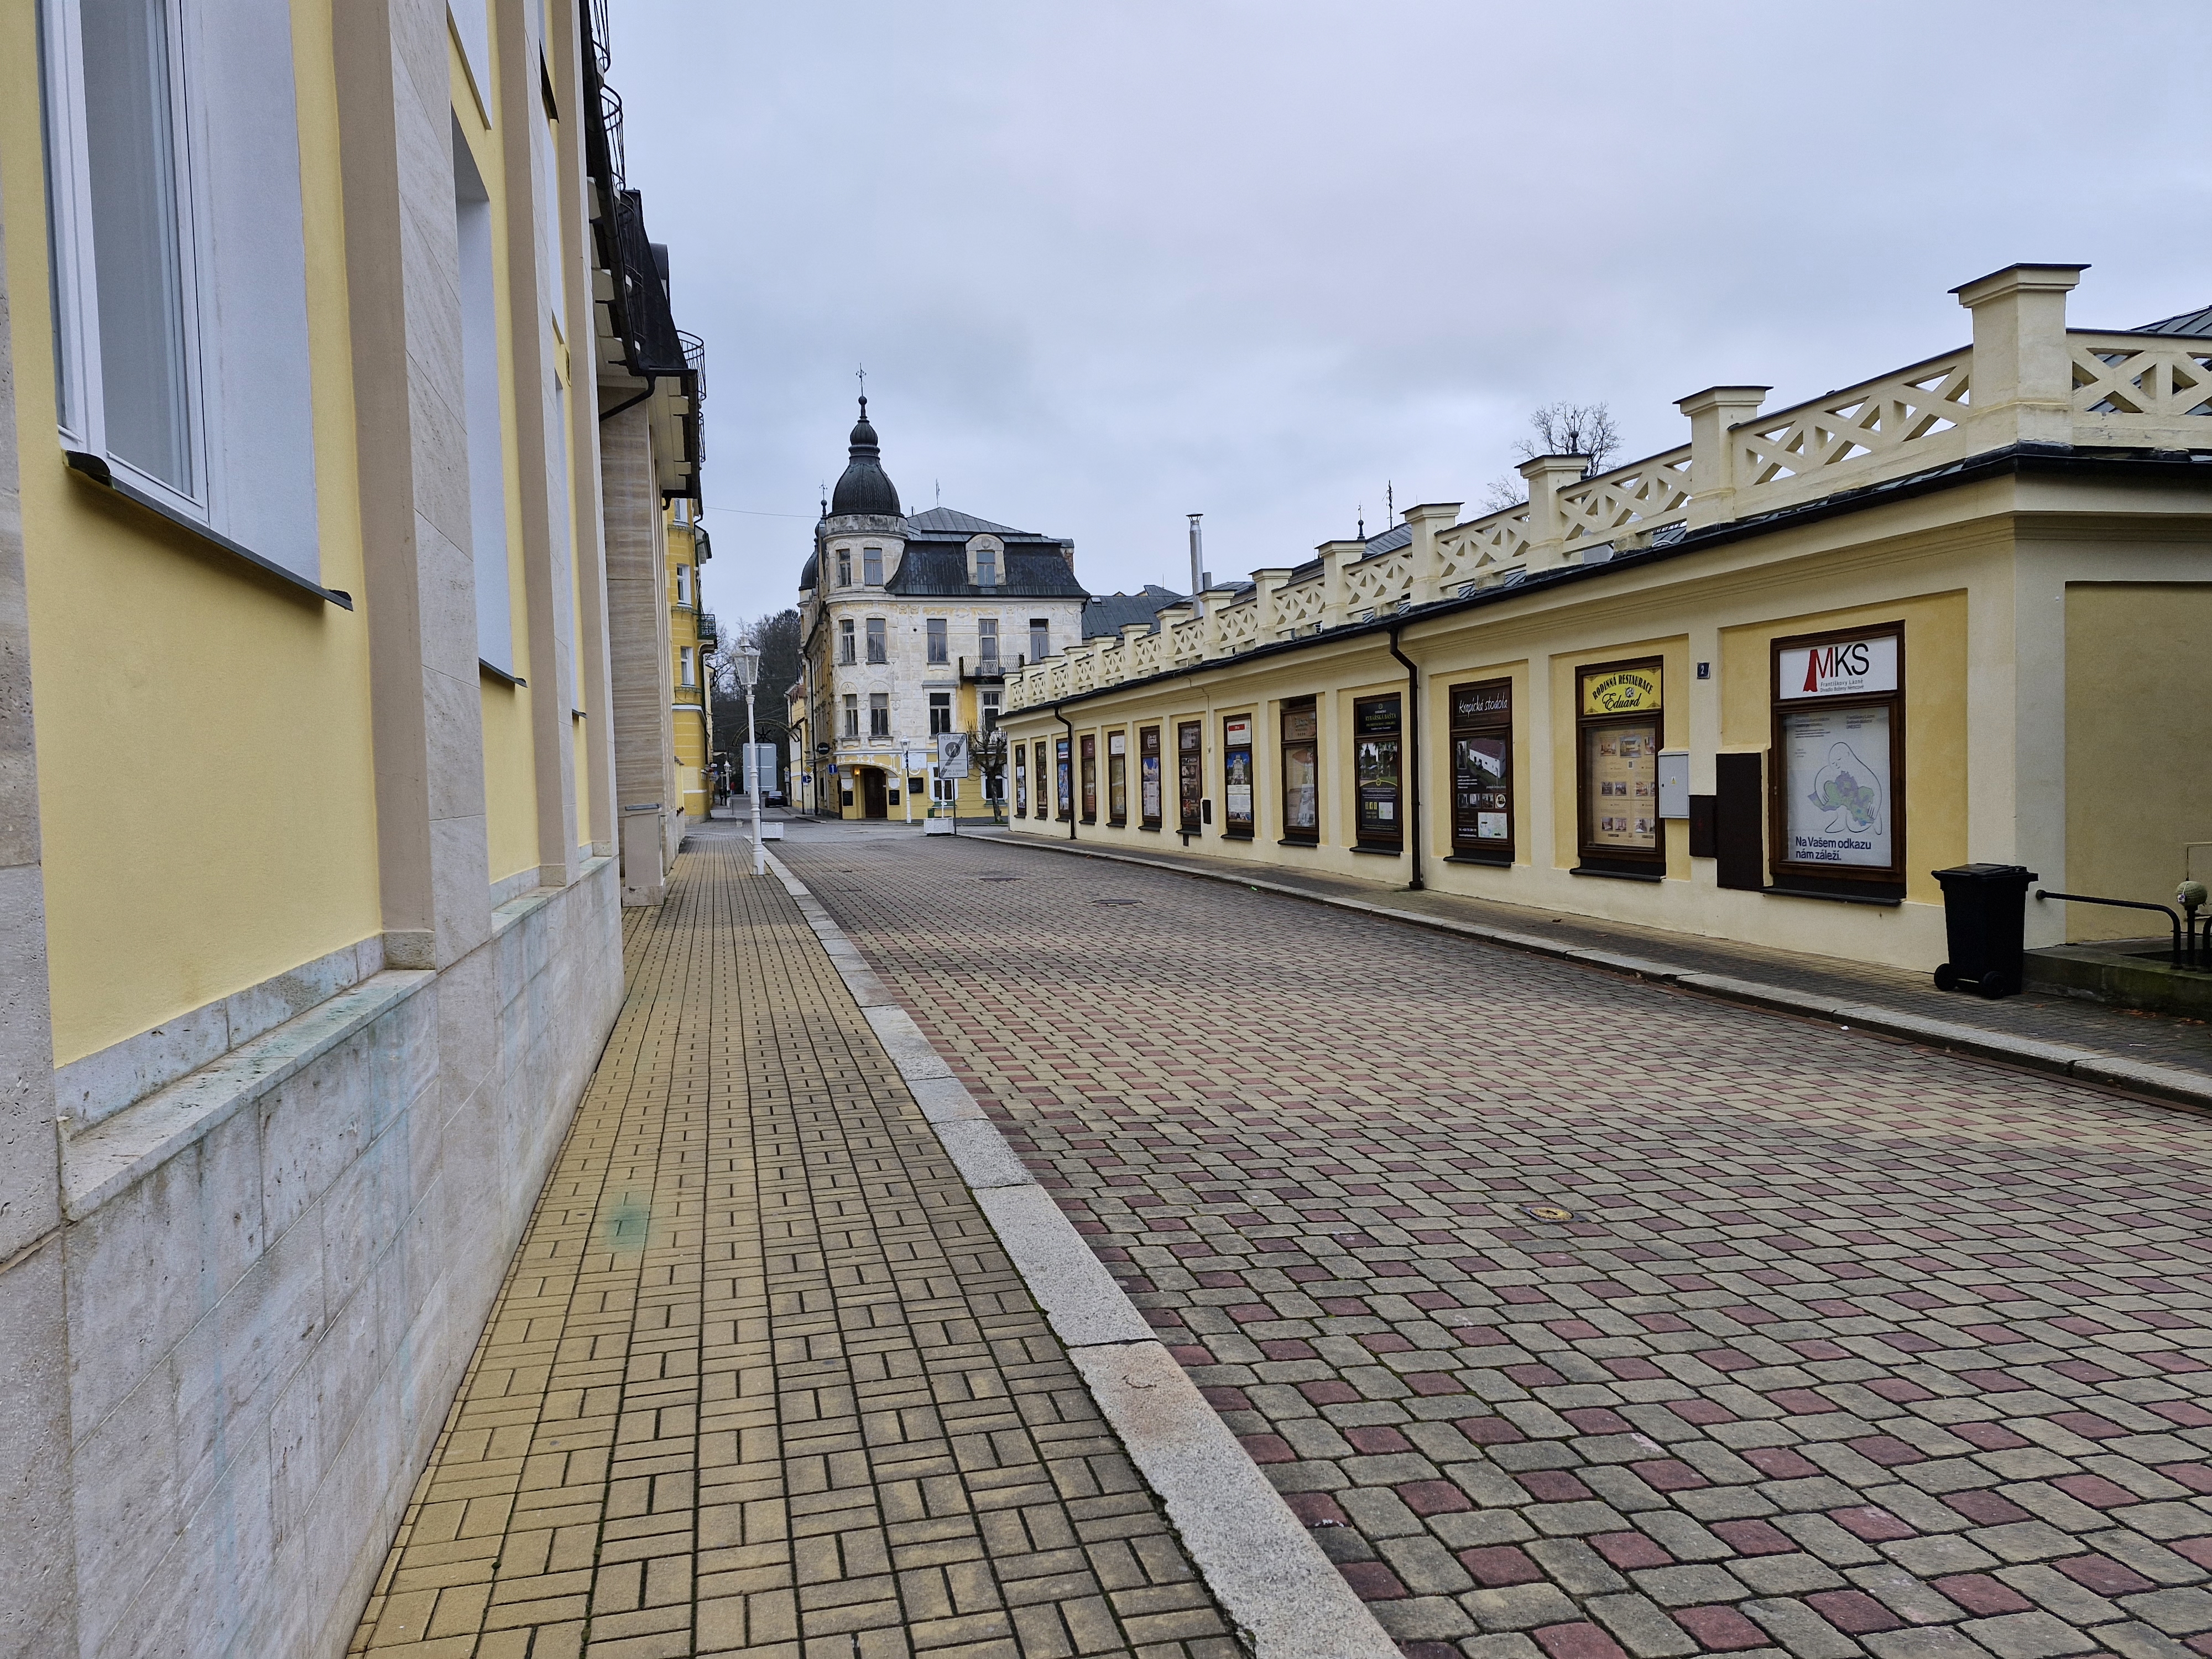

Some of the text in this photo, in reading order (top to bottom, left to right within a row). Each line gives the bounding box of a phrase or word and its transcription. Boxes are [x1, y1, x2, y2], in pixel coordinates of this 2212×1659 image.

[1700, 665, 1704, 675] 2
[1803, 643, 1869, 692] MKS
[1592, 674, 1653, 700] RODINNÁ RESTAURACE
[1459, 692, 1507, 718] Krapická stodola
[1602, 692, 1642, 711] Eduard
[1796, 836, 1871, 849] Na Vašem odkazu
[1796, 848, 1841, 860] nám záleží.
